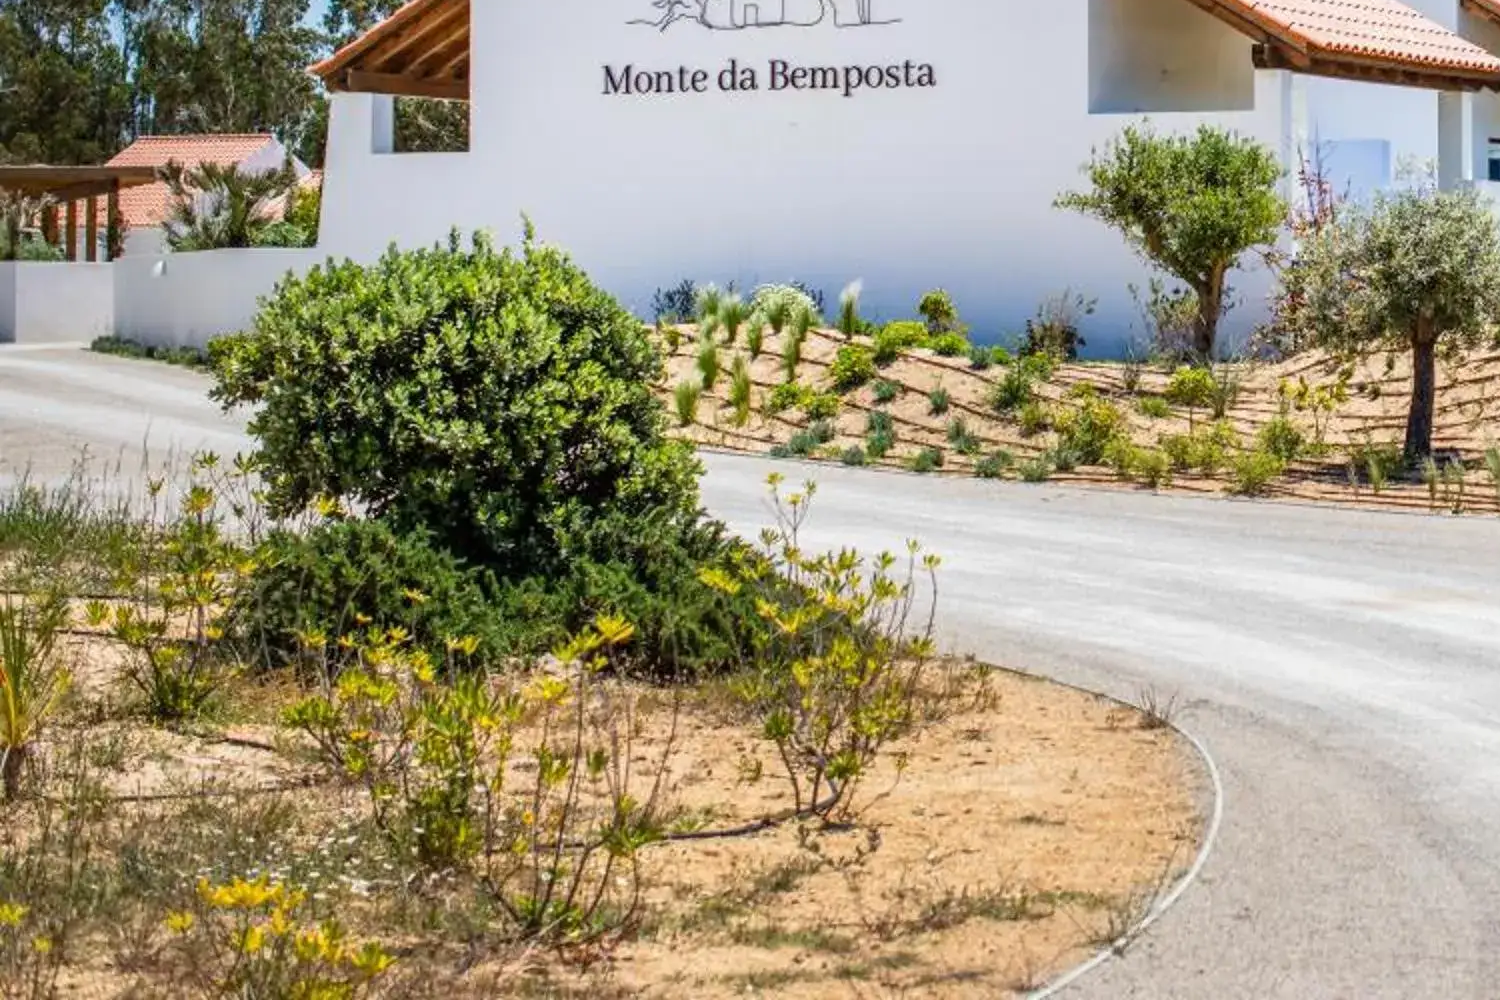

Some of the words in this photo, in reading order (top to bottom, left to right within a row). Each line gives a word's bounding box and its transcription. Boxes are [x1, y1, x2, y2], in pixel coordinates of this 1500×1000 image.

[602, 64, 708, 95] Monte
[717, 59, 759, 92] da
[768, 59, 937, 97] Bemposta
